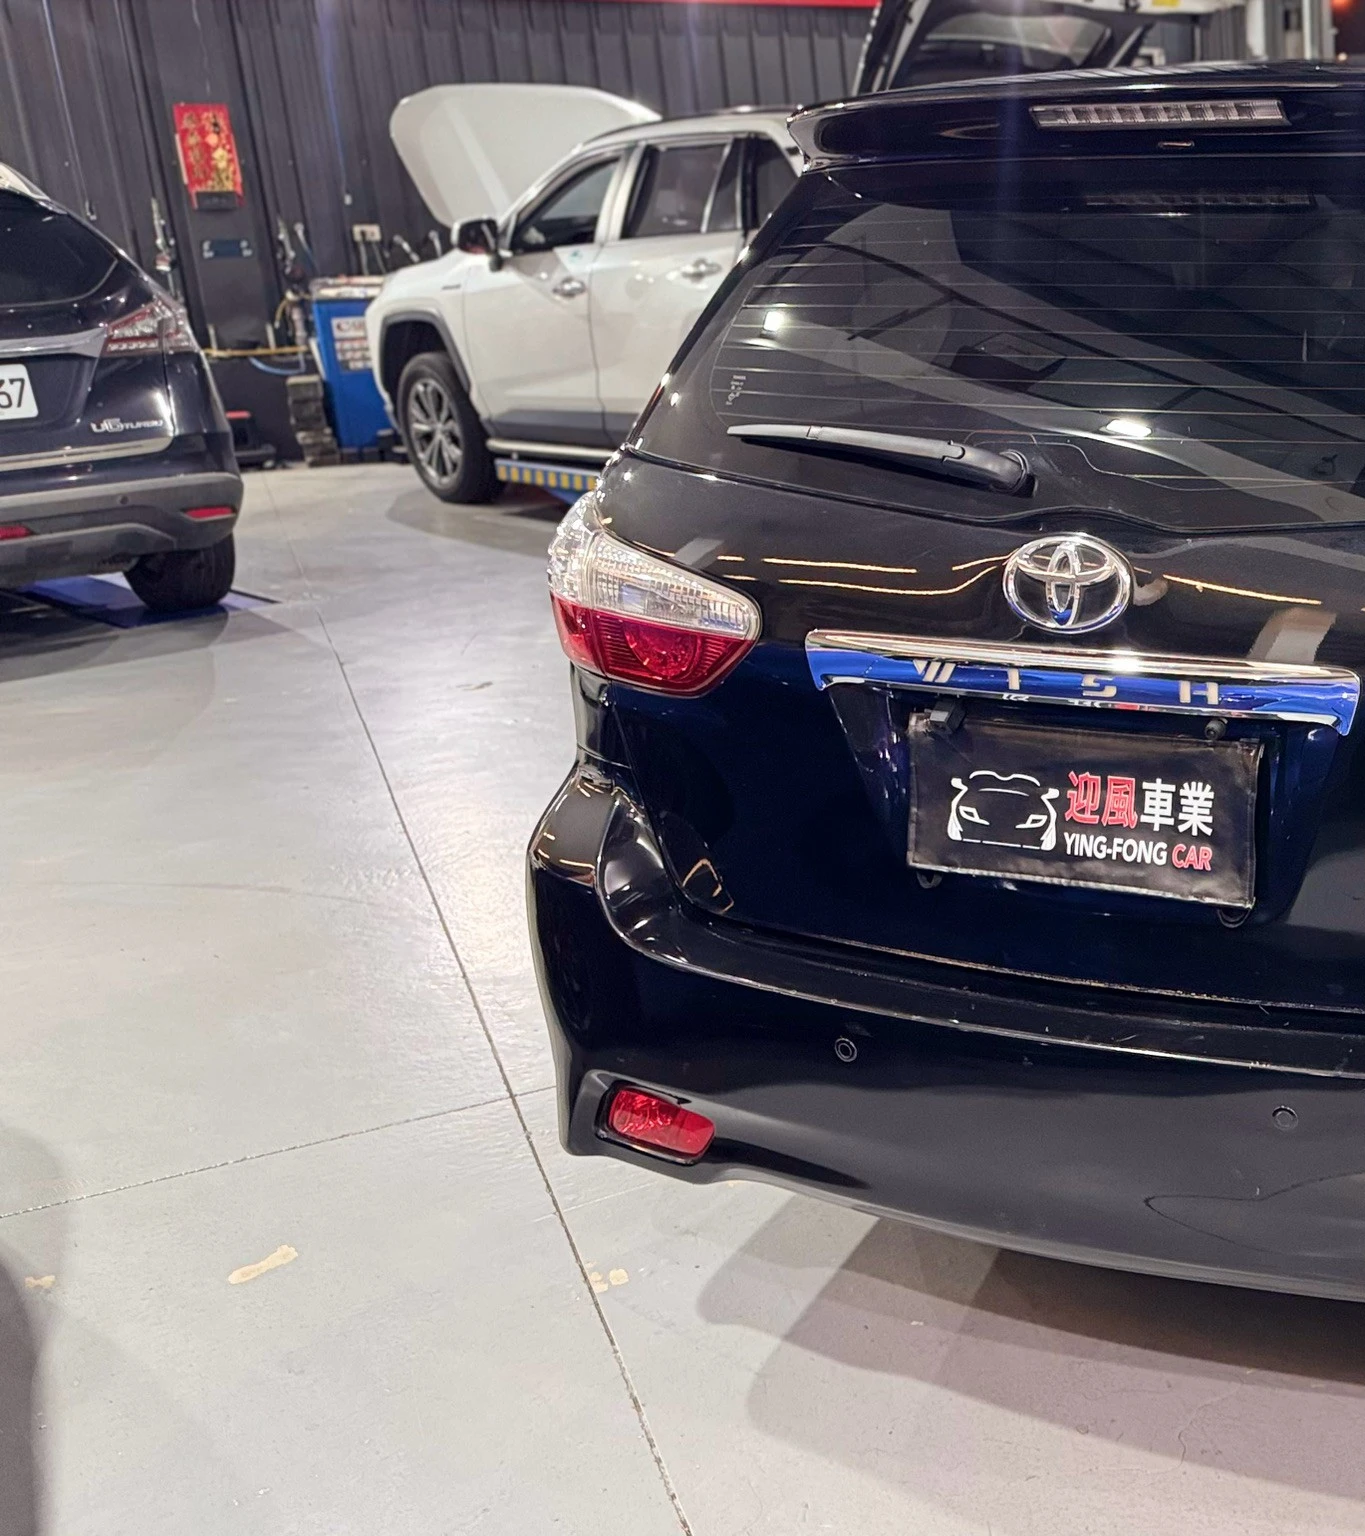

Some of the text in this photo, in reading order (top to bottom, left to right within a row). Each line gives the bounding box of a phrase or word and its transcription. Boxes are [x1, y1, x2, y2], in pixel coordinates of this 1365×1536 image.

[912, 659, 1219, 704] WISH
[1064, 770, 1215, 836] 迎風車業
[1063, 831, 1213, 871] YING-FONG CAR
